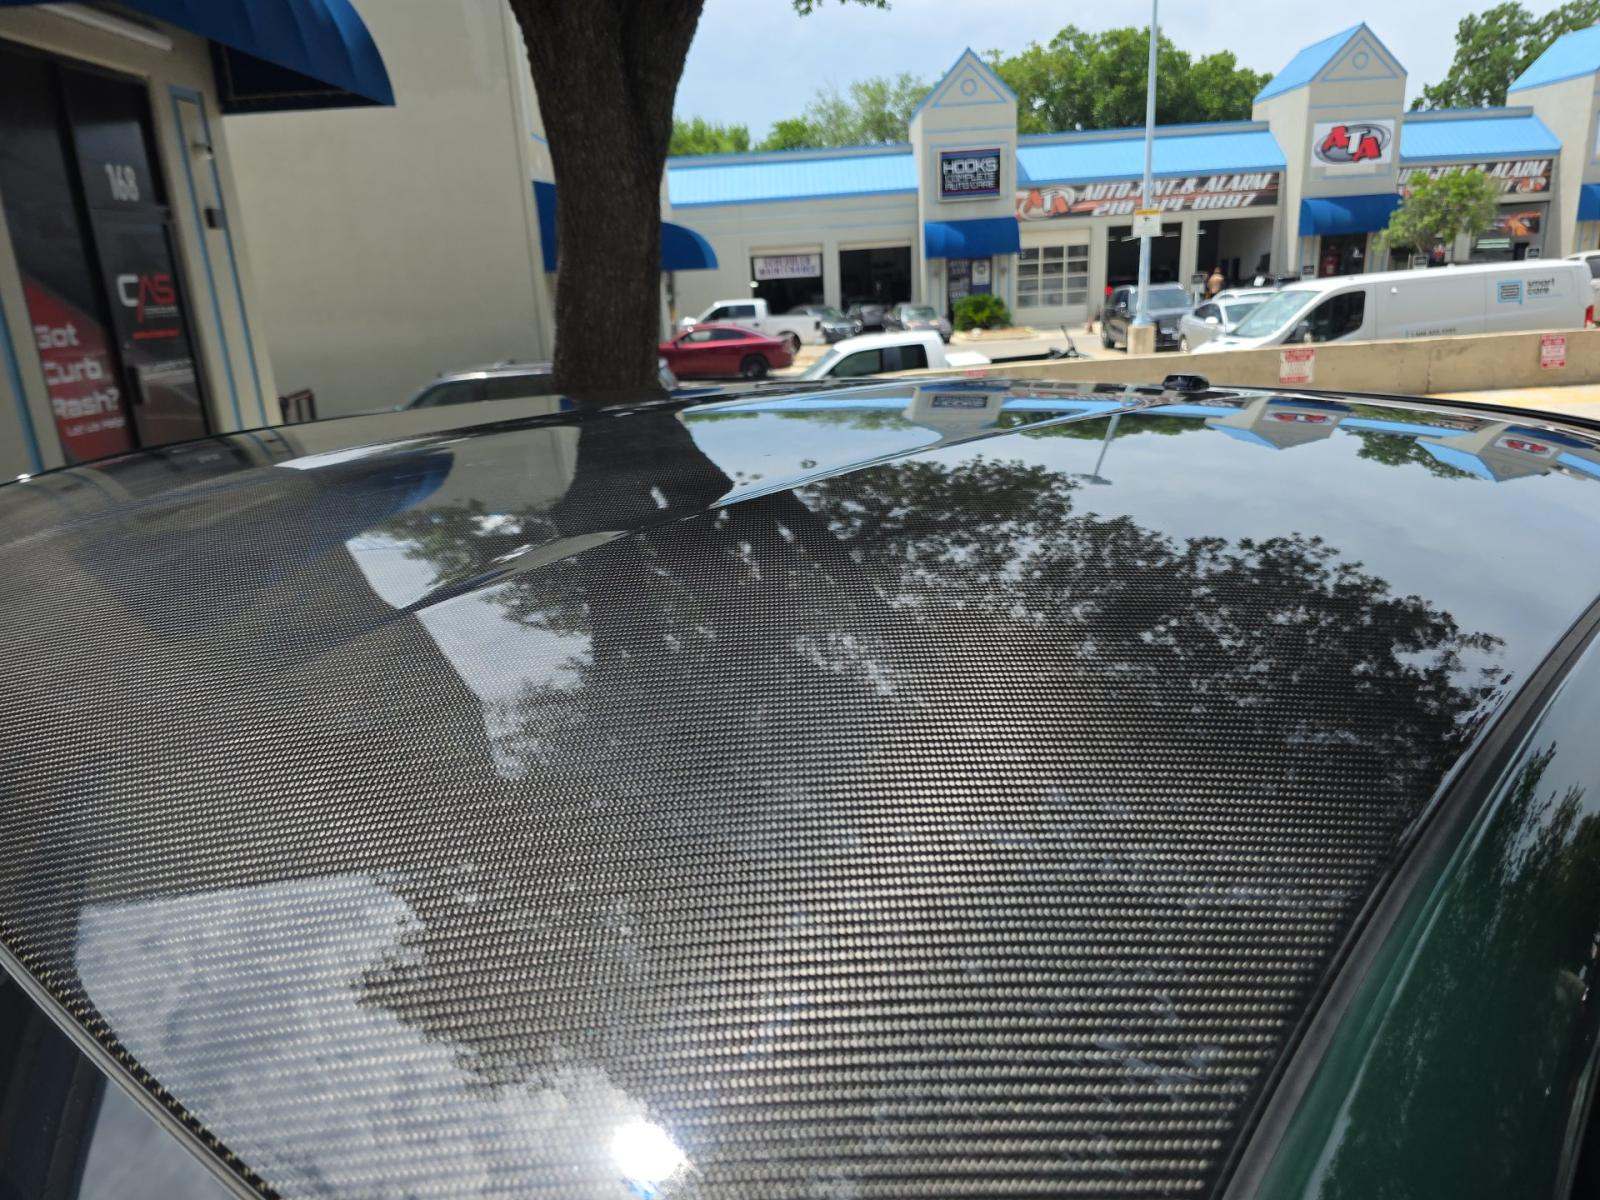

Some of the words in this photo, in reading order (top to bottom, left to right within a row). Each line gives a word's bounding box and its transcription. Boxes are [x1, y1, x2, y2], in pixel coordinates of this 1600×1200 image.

[1321, 125, 1382, 162] ATA
[105, 163, 140, 201] 168
[943, 157, 998, 176] HOOKS
[1078, 183, 1132, 201] AUTO
[1203, 173, 1272, 193] ALARM
